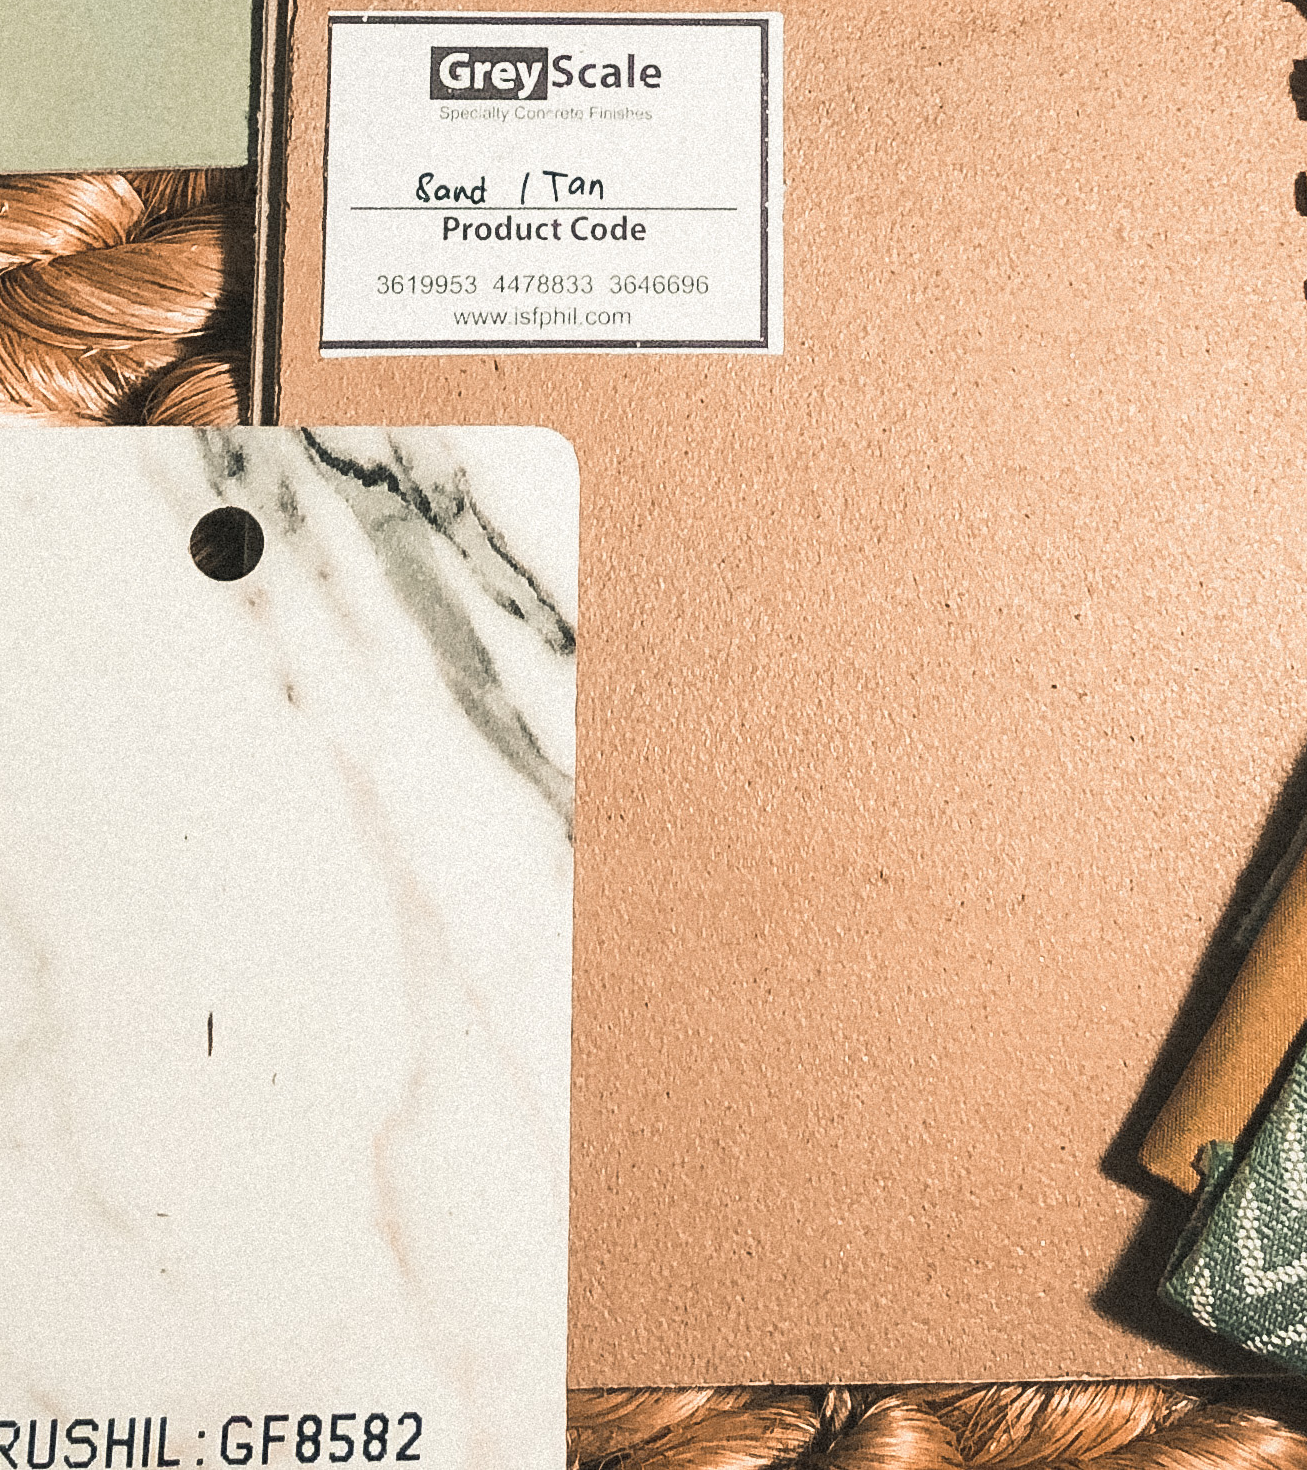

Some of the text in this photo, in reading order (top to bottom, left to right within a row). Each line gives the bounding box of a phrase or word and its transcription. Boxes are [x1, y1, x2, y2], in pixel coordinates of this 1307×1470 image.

[439, 105, 653, 122] Specialty Concrete Finishes
[442, 214, 648, 241] Product Code
[376, 274, 710, 295] 3619953 4478833 3646696
[453, 307, 632, 330] www.isfphil.com
